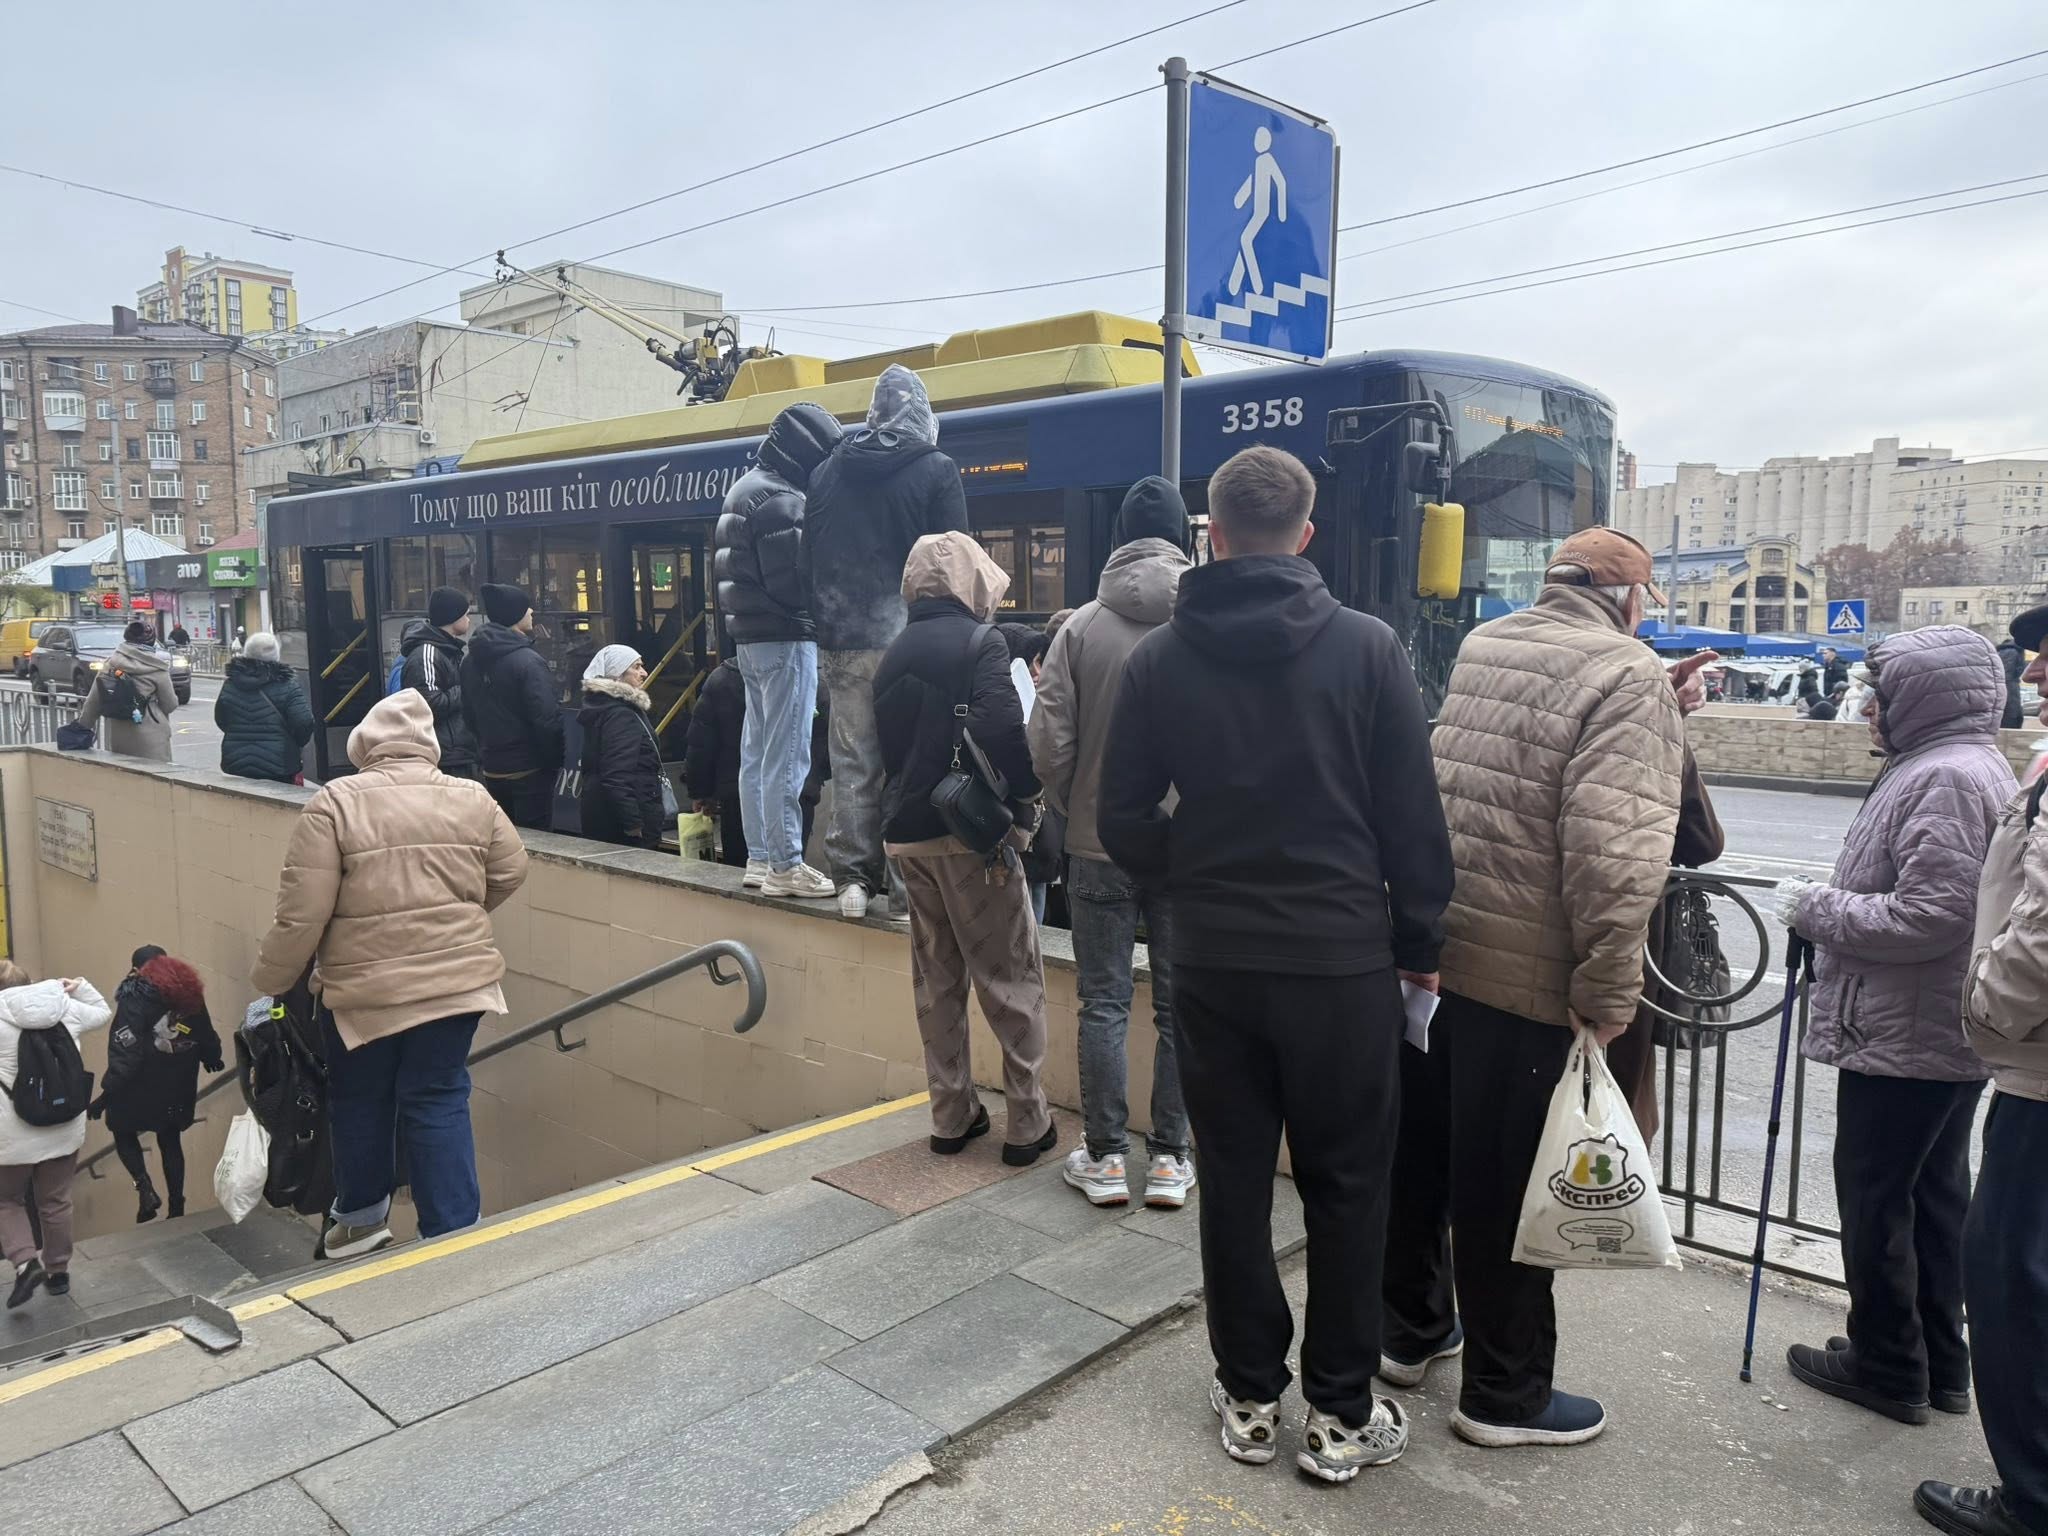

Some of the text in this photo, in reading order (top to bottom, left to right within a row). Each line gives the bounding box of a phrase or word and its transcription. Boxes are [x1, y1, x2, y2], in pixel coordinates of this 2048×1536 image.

[1221, 396, 1304, 434] 3358
[409, 450, 757, 529] Тому що ваш кіт особливи
